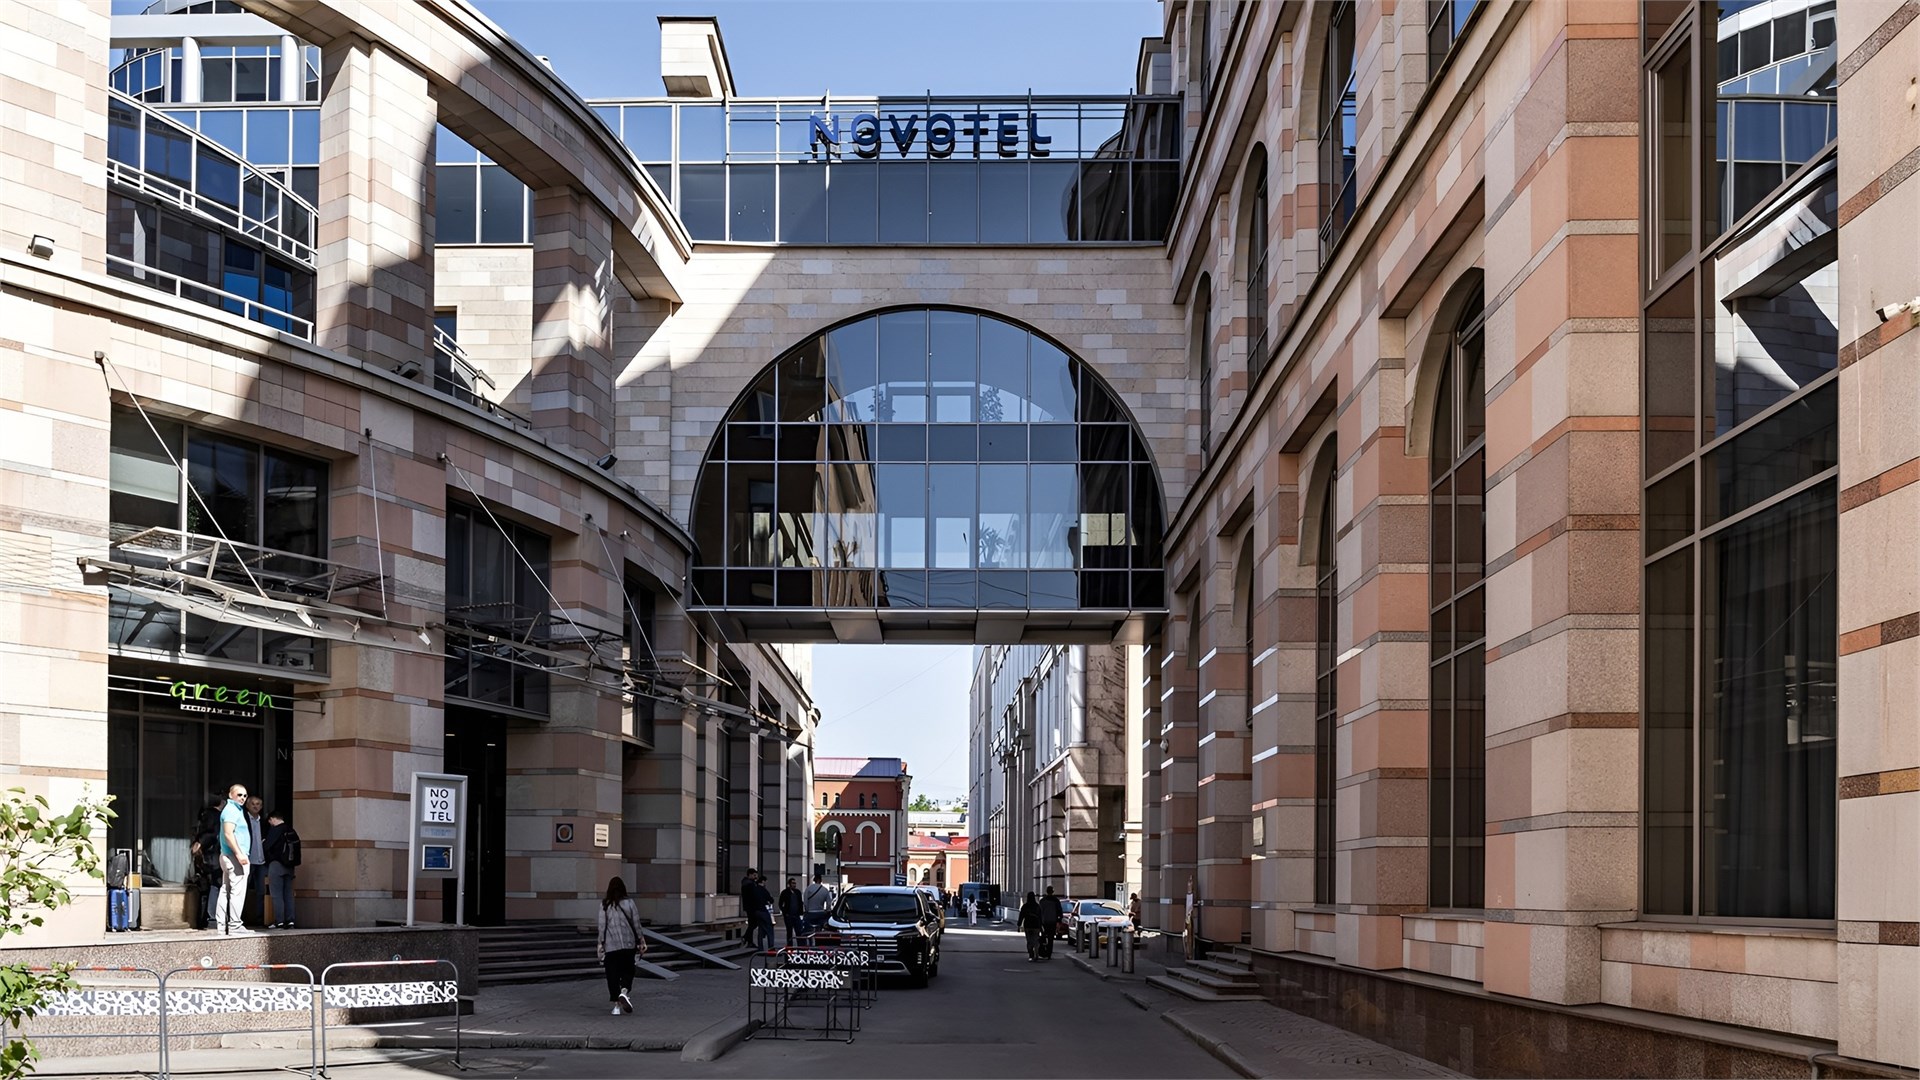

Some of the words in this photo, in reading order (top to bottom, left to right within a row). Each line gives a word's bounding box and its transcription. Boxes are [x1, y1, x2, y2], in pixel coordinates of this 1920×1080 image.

[810, 113, 1052, 146] NOVOTEL
[430, 788, 449, 798] NO
[430, 800, 449, 810] VO
[429, 811, 452, 821] TEL
